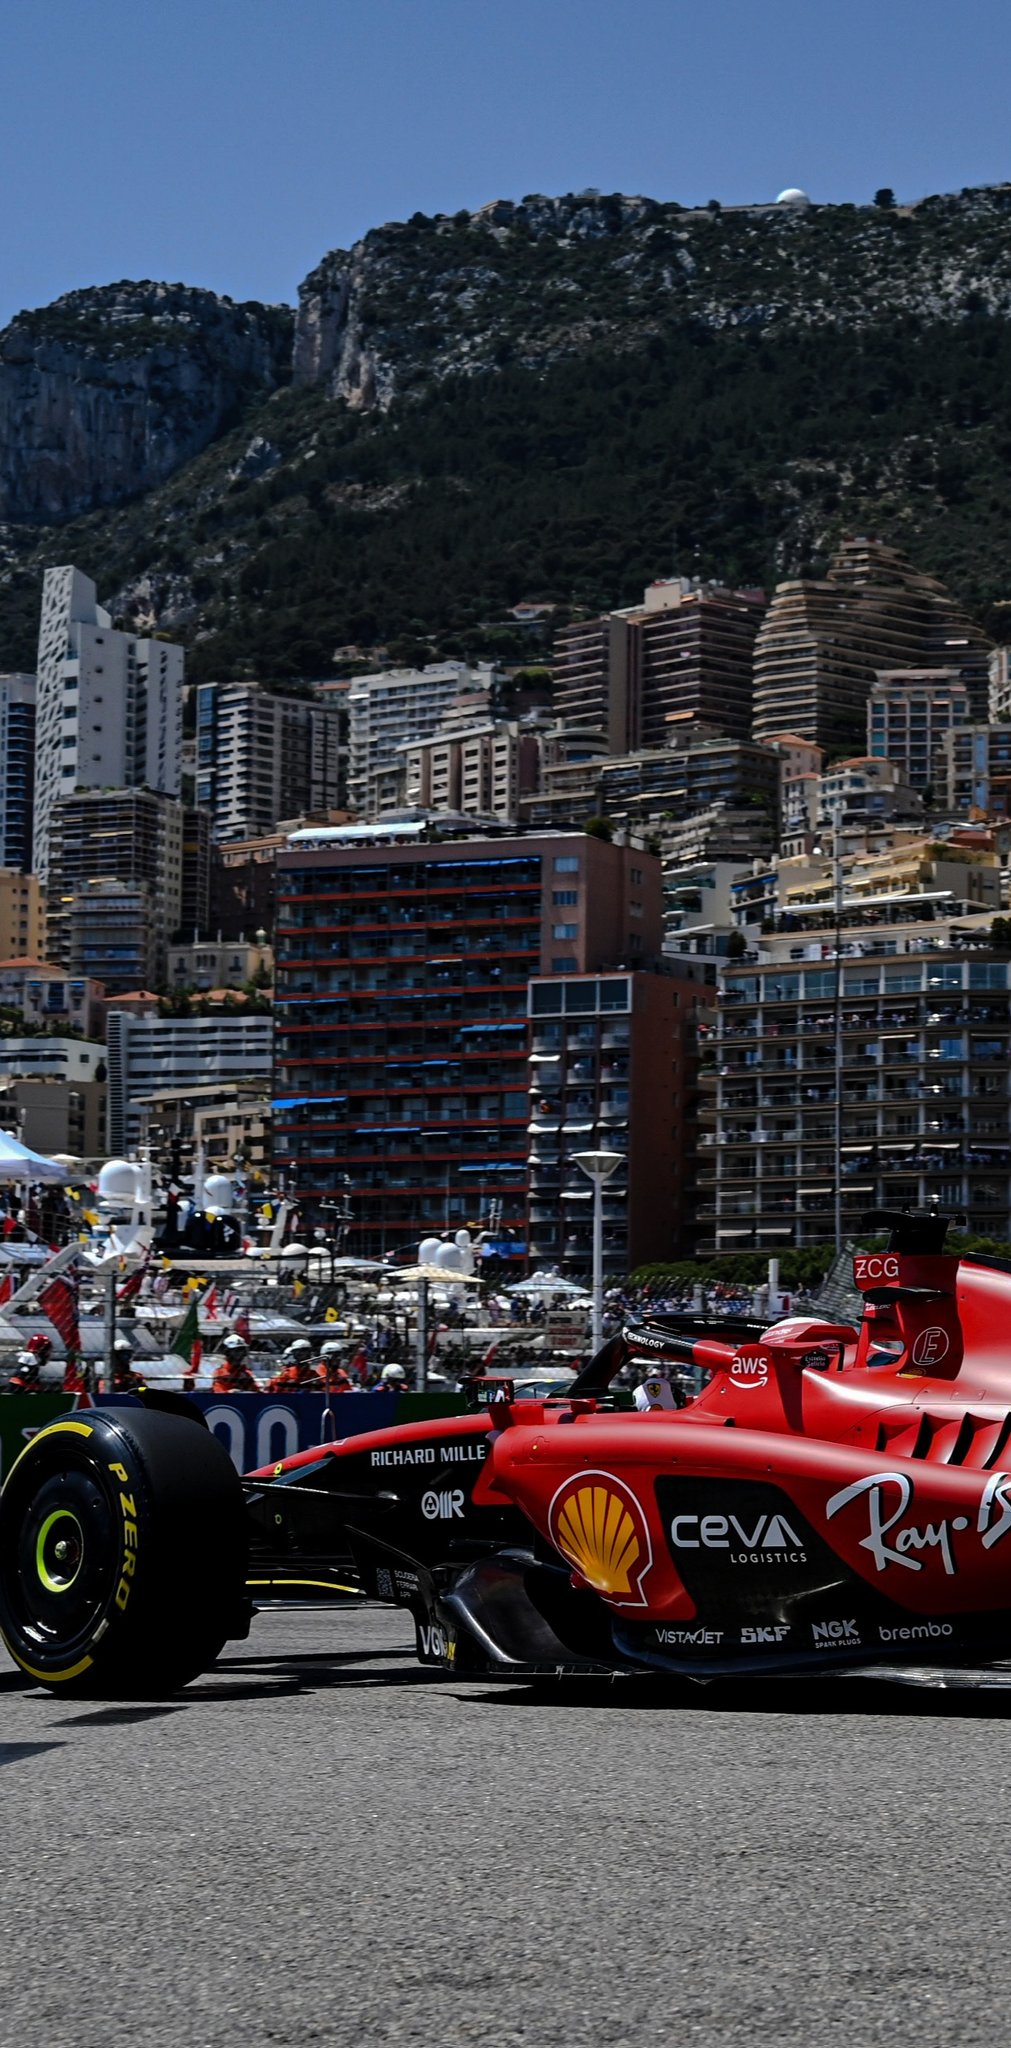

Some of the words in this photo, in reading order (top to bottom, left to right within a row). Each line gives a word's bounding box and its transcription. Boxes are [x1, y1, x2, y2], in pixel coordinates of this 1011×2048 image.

[855, 1257, 899, 1279] ZCG
[731, 1357, 768, 1375] aws
[371, 1448, 435, 1466] RICHARD
[440, 1445, 486, 1462] MILLE
[108, 1462, 128, 1482] P
[115, 1492, 138, 1610] ZERO
[730, 1553, 807, 1563] LOGISTICS
[740, 1625, 791, 1643] SKF
[811, 1619, 859, 1640] NGK
[879, 1622, 953, 1641] brembo
[838, 1638, 862, 1647] PLUGS
